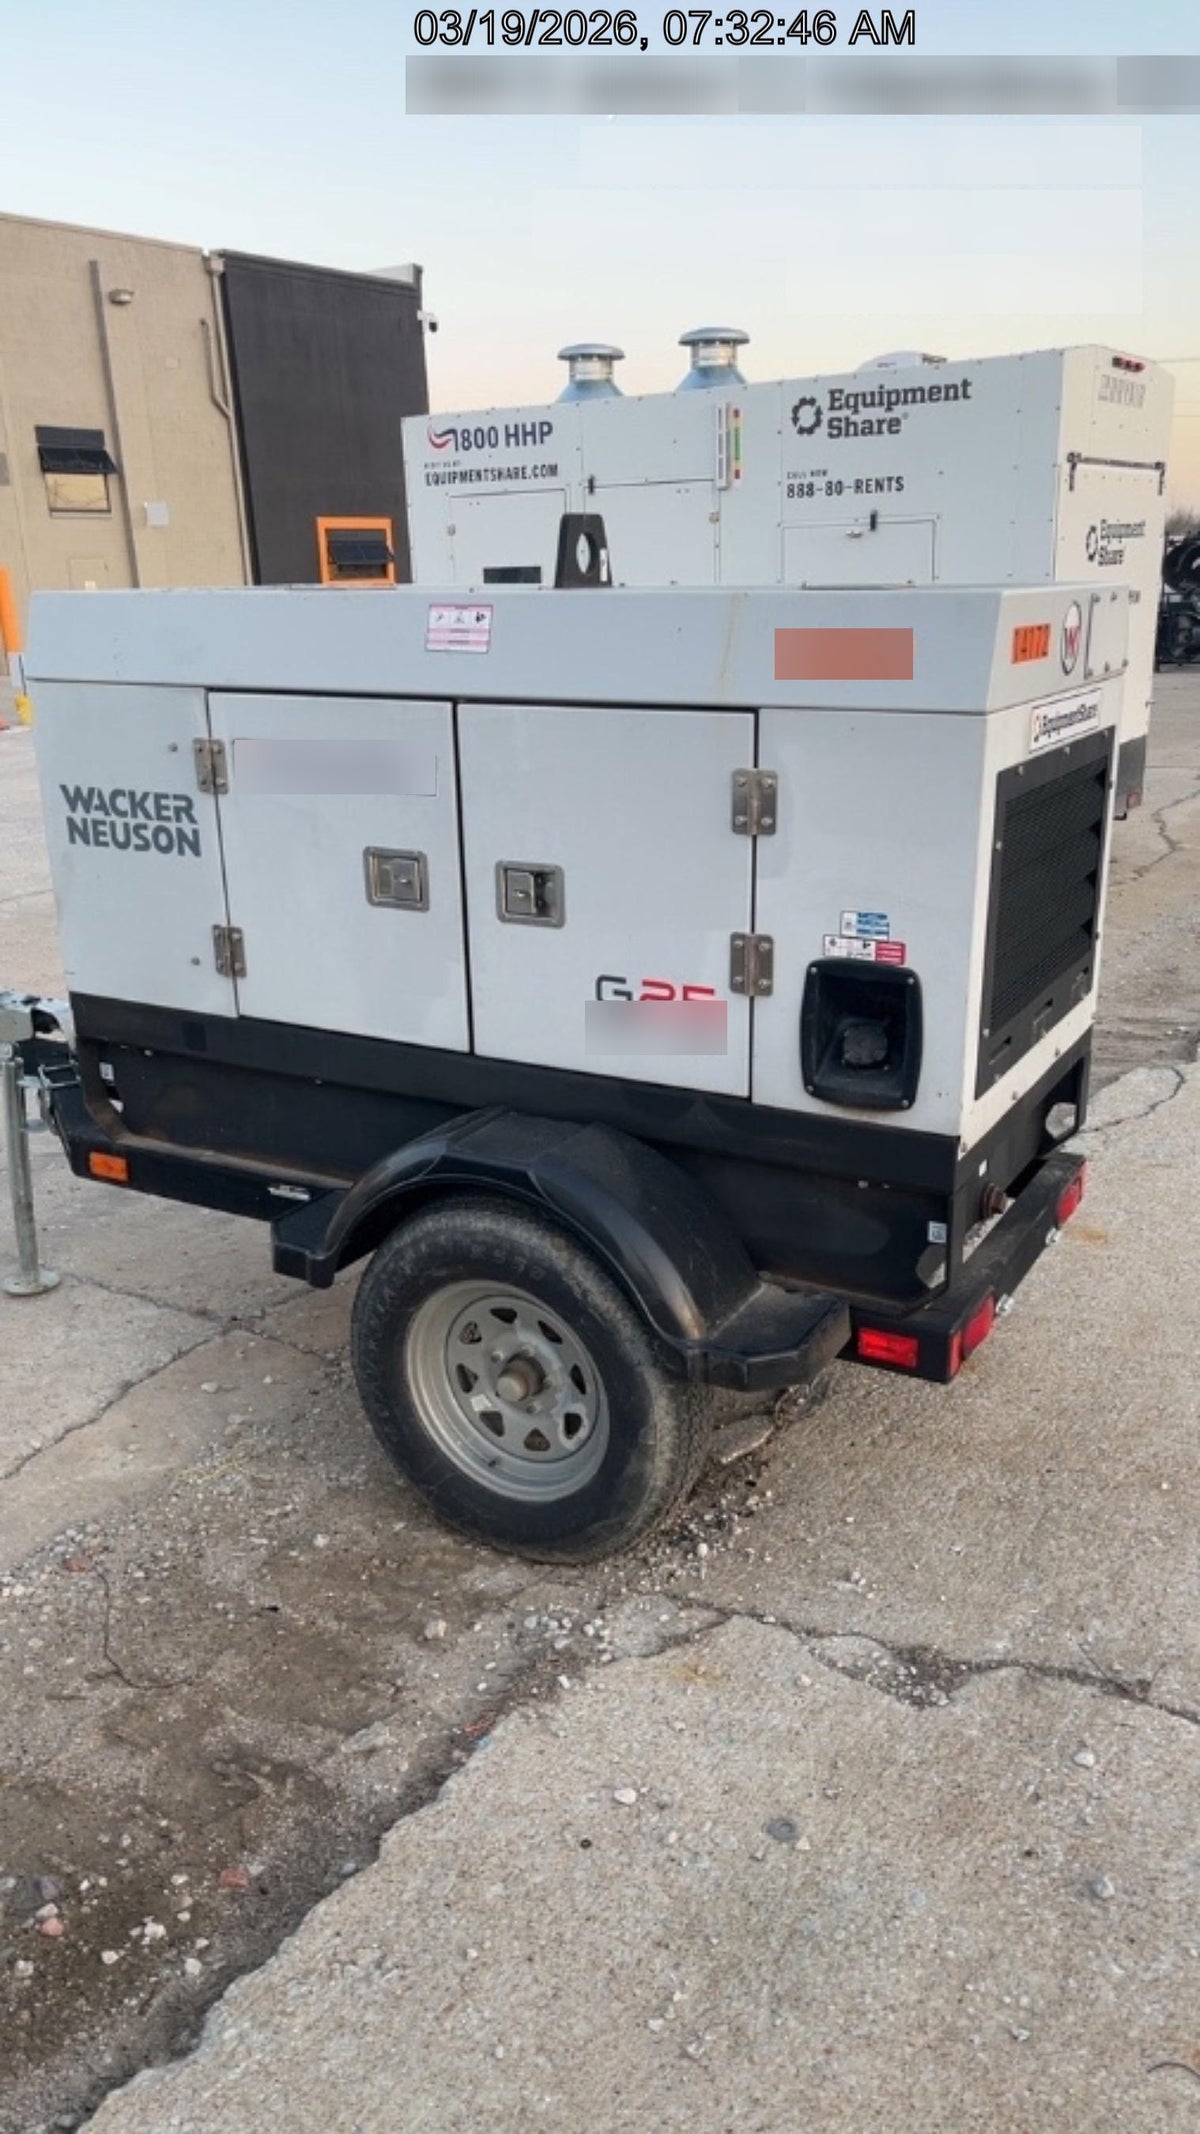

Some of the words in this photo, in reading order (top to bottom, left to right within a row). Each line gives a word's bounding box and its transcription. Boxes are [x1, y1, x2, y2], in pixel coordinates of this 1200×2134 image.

[827, 379, 972, 414] Equipment
[504, 420, 554, 448] HHP
[827, 415, 903, 440] Share
[424, 463, 559, 487] EQUIPMENTSHARE.COM
[786, 476, 905, 499] 888-80-RENTS
[1099, 518, 1146, 544] Equipment
[59, 783, 198, 825] WACKER
[66, 816, 202, 857] NEUSON
